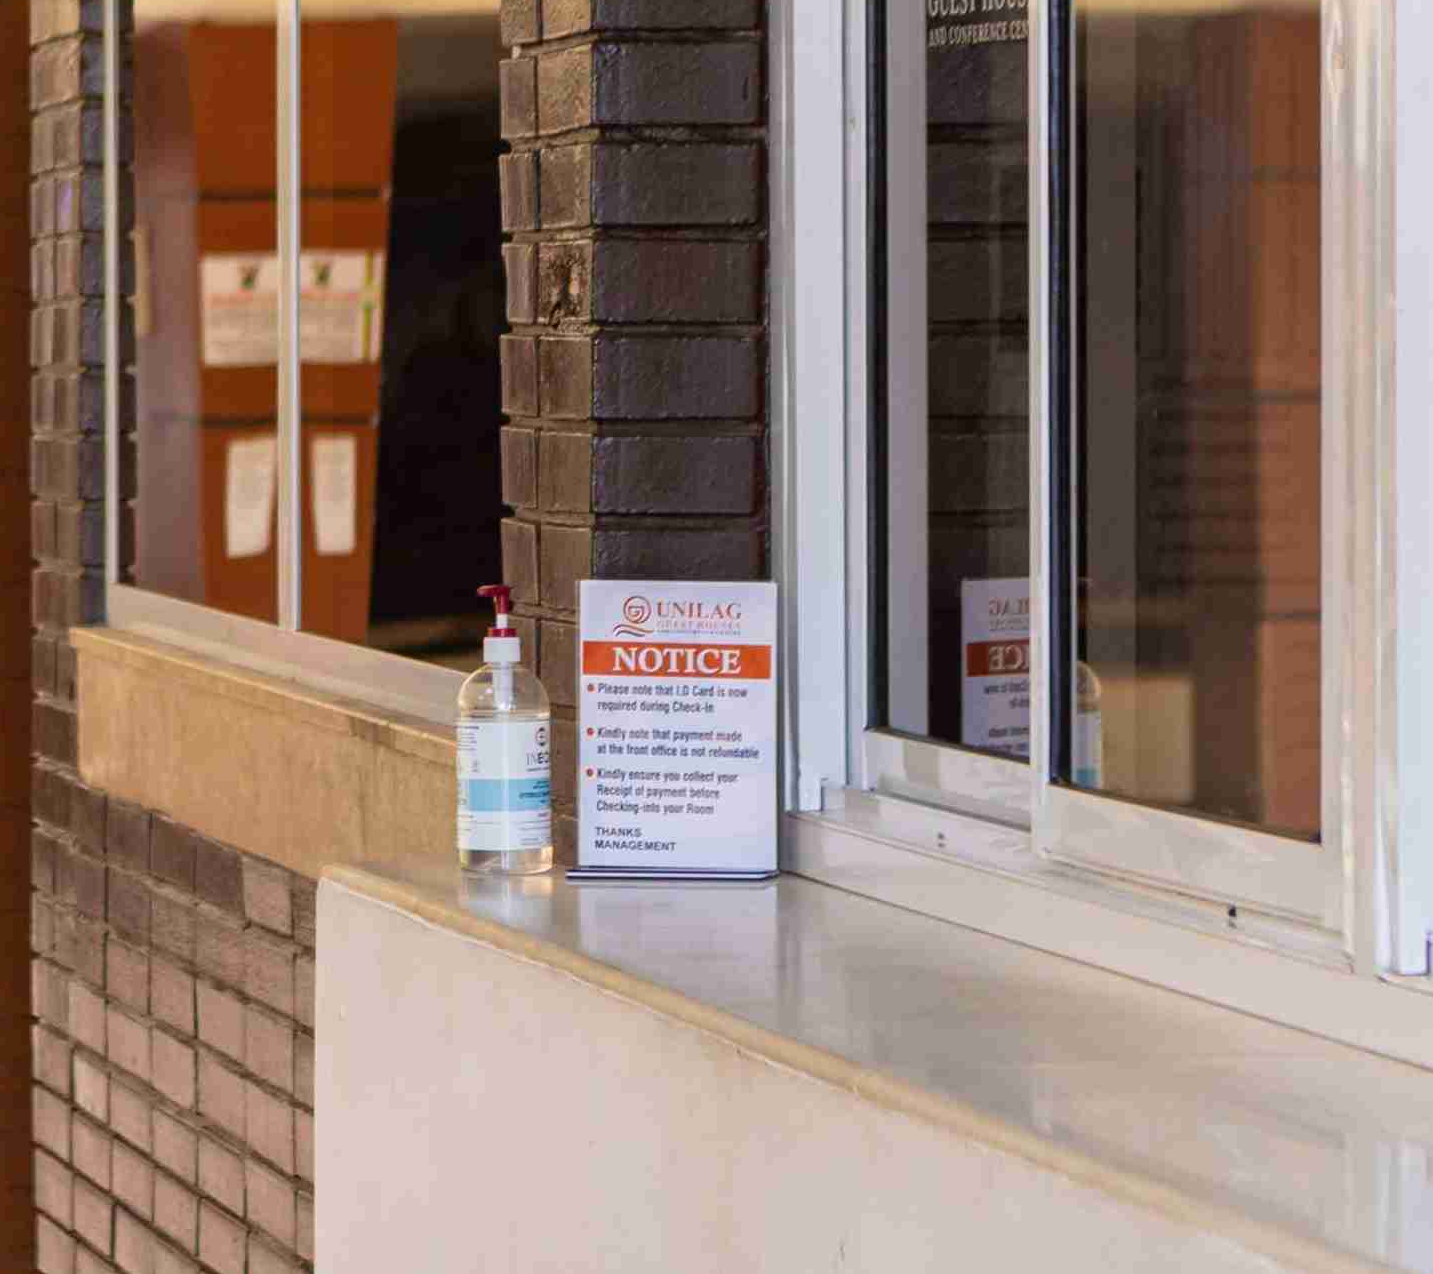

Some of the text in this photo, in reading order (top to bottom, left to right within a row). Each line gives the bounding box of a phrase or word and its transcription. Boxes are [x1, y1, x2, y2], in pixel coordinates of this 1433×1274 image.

[657, 602, 741, 619] UNILAG
[613, 646, 741, 674] NOTICE
[598, 683, 629, 695] Please
[632, 685, 653, 695] note
[655, 684, 673, 696] that
[692, 685, 714, 696] Card
[597, 701, 637, 712] required
[640, 701, 670, 714] during
[597, 727, 742, 743] Kindly note that payment made
[597, 744, 607, 754] at
[609, 744, 624, 755] the
[627, 744, 649, 755] front
[651, 745, 678, 756] office
[691, 746, 706, 757] not
[709, 747, 760, 759] refundable
[597, 768, 739, 785] Kindly ensure you collect your
[596, 784, 633, 798] Receipt
[646, 786, 686, 800] payment
[689, 787, 720, 799] before
[663, 803, 684, 815] your
[686, 804, 714, 815] Room
[595, 827, 642, 838] THANKS
[594, 839, 677, 852] MANAGEMENT
